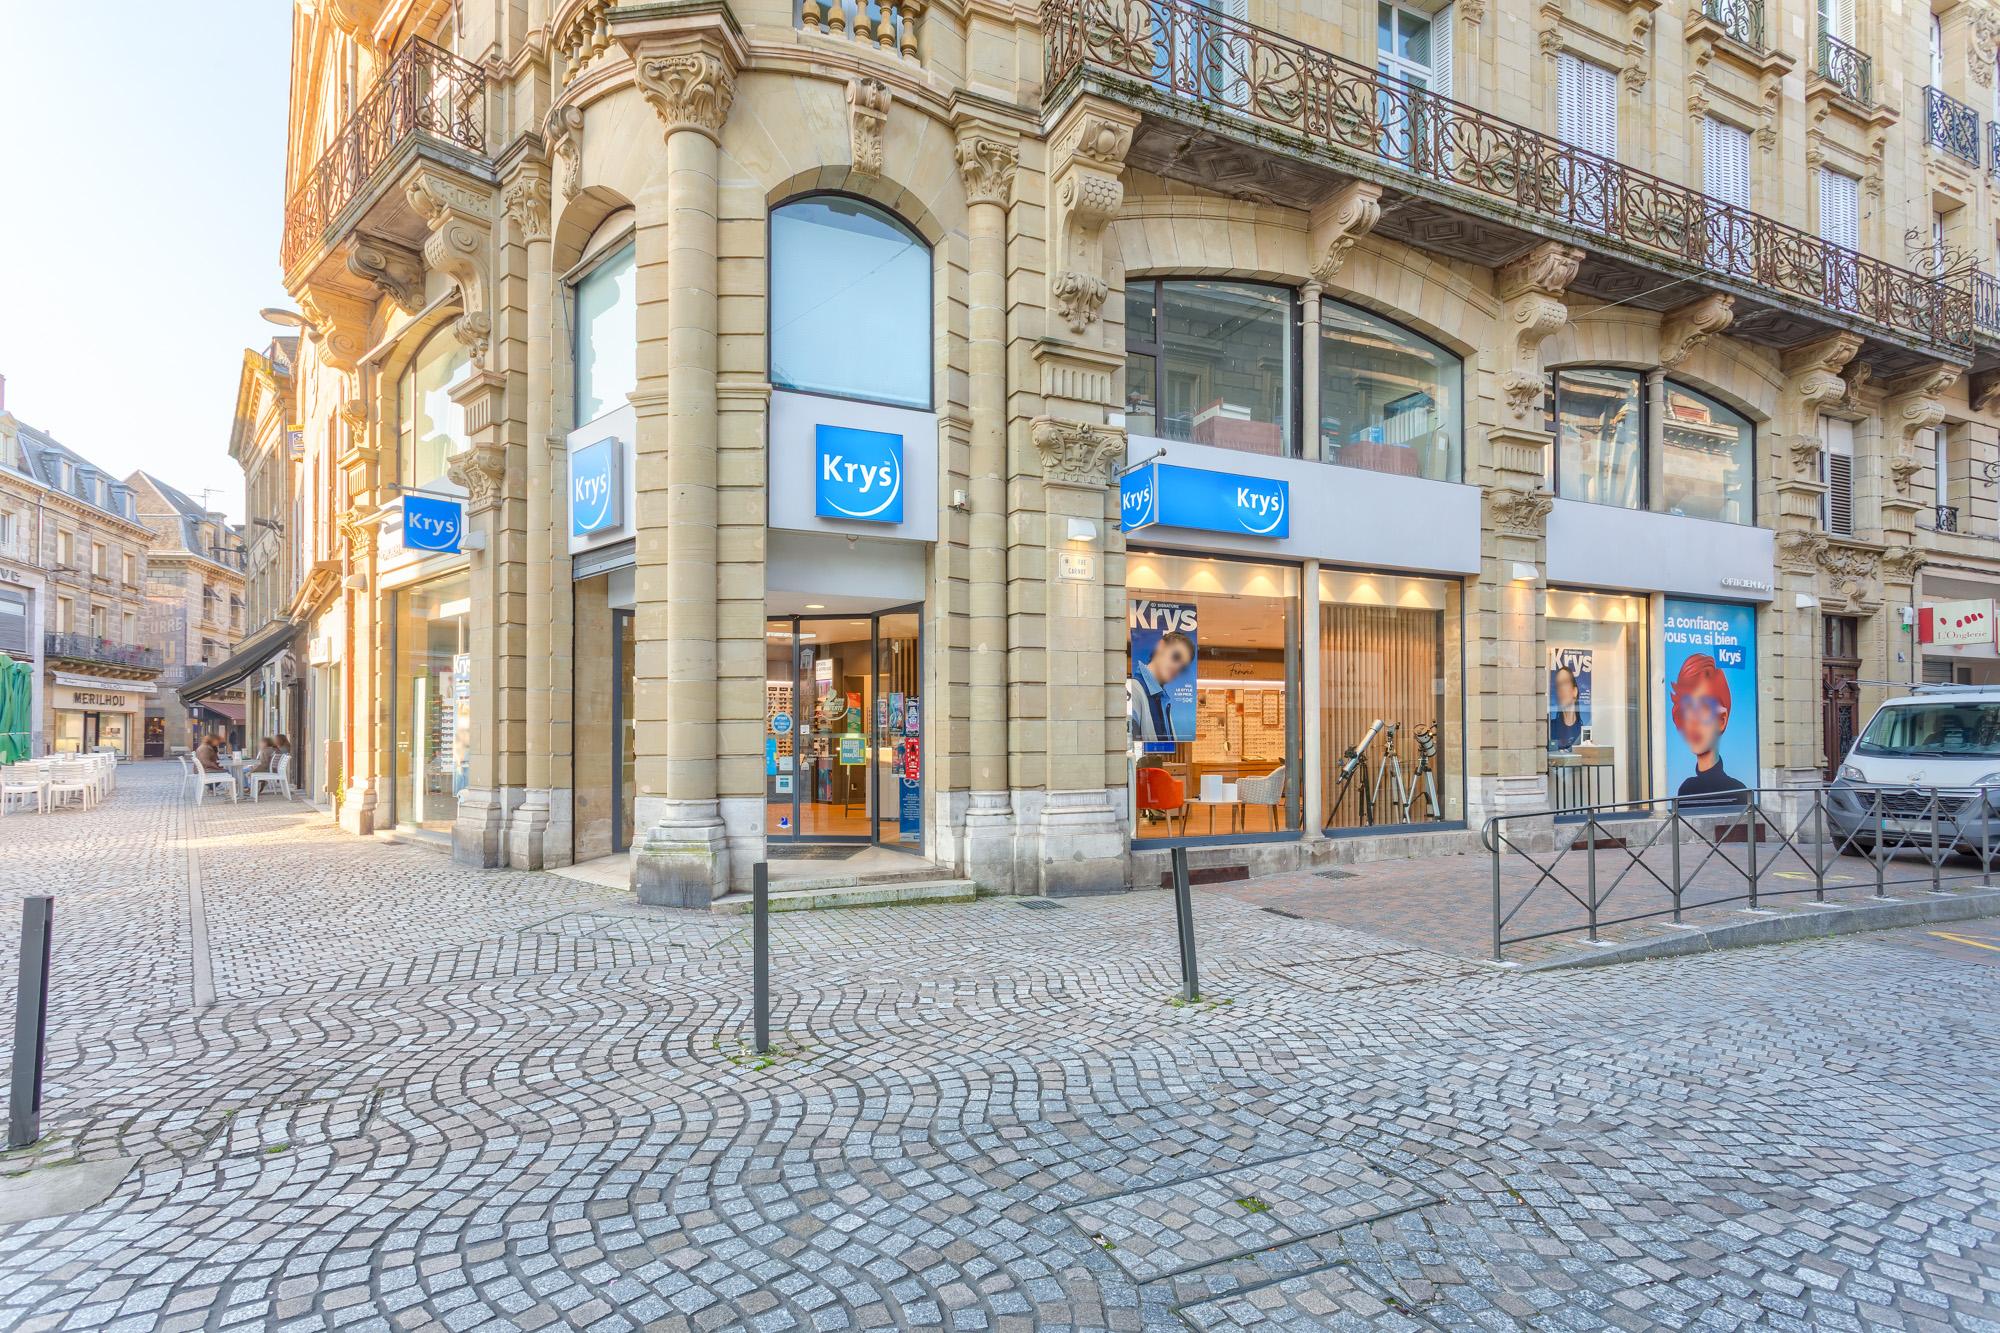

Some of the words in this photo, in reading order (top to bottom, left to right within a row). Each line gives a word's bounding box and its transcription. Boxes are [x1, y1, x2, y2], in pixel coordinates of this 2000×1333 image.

[823, 453, 892, 493] Krys
[575, 473, 607, 506] Krys
[1122, 487, 1150, 511] Krys
[1237, 487, 1280, 516] Krys
[409, 512, 455, 536] Krys
[1129, 600, 1198, 636] Krys
[1676, 616, 1729, 631] confiance
[1689, 634, 1702, 645] va
[1704, 632, 1713, 645] si
[1714, 632, 1738, 646] bien
[1937, 631, 1988, 640] L'Onglerie
[1551, 648, 1593, 677] Krys
[1719, 649, 1742, 664] Krys
[73, 692, 126, 706] MERILHOU
